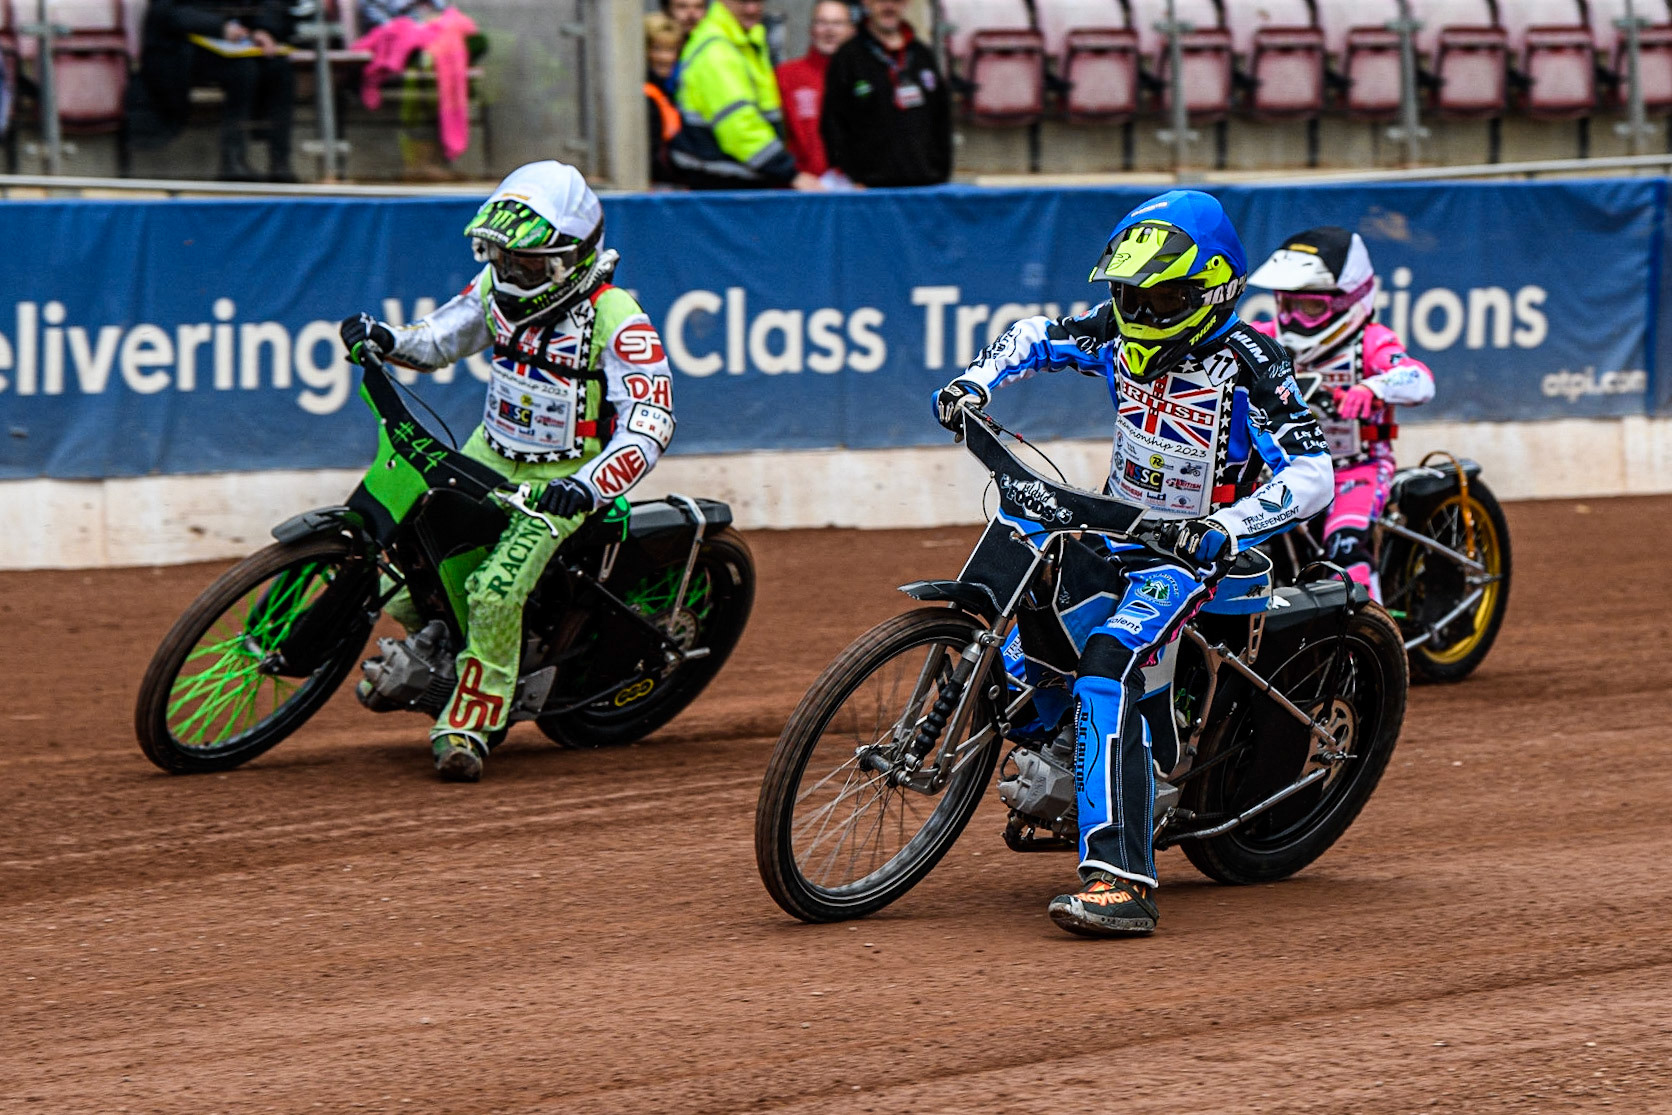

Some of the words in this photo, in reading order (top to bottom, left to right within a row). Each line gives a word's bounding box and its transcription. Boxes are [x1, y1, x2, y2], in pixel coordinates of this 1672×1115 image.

[665, 287, 887, 377] Class
[1189, 314, 1217, 346] THOR
[1229, 331, 1269, 364] MUM
[1209, 354, 1233, 379] 77
[627, 377, 670, 407] DH
[1174, 444, 1206, 458] 2023
[596, 450, 645, 494] KNE
[1126, 460, 1161, 486] NSSC
[1242, 512, 1265, 527] TRULY
[1247, 505, 1299, 533] INDEPENDENT
